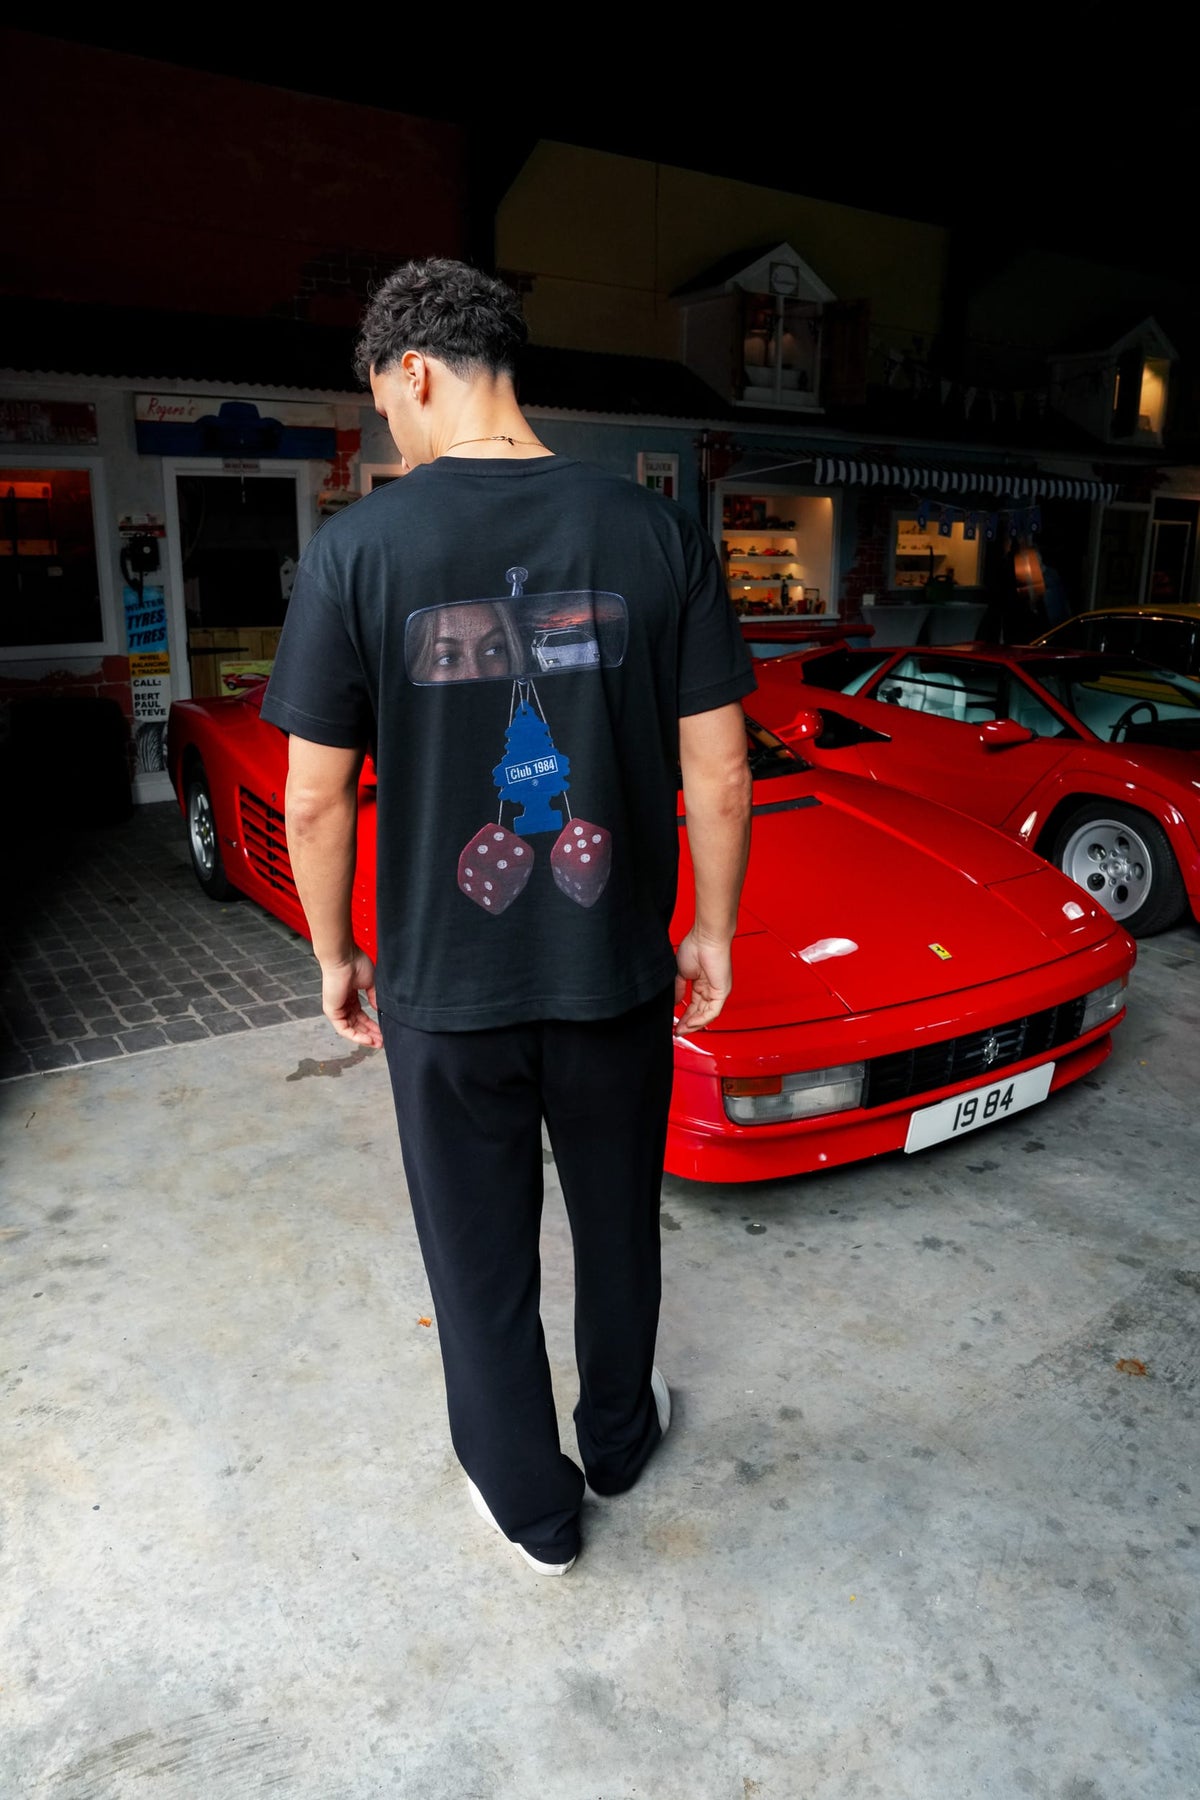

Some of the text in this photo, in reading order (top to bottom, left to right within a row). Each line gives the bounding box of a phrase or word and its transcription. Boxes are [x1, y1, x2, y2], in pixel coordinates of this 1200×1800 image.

[127, 608, 165, 630] TYRES
[128, 626, 166, 648] TYRES
[133, 679, 161, 687] CALL:
[134, 692, 160, 701] BERT
[134, 701, 161, 709] PAUL
[135, 708, 167, 717] STEVE
[510, 758, 555, 780] Club 1984
